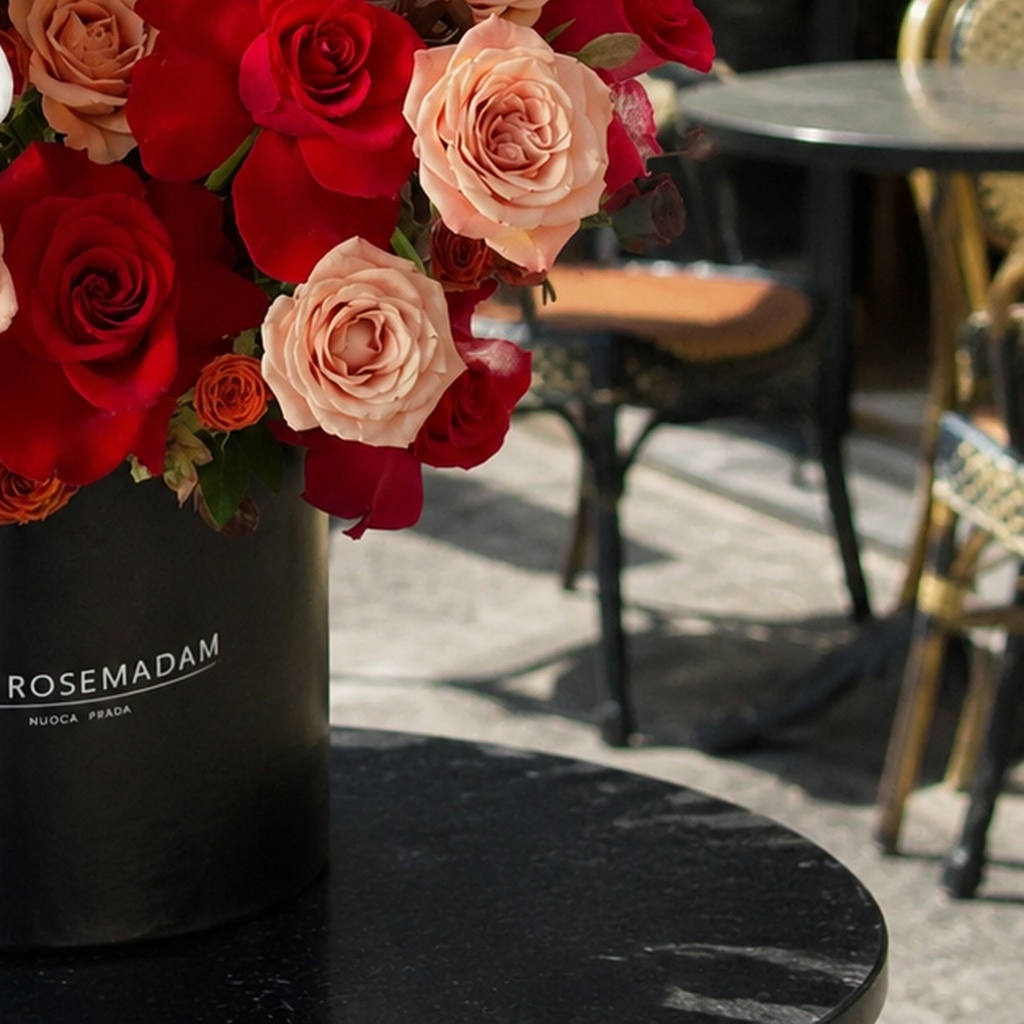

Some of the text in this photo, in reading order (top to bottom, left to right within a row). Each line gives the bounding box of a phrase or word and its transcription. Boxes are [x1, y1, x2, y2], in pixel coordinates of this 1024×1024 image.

[8, 633, 219, 699] ROSEMADAM
[29, 705, 132, 726] NUOCA PRADA
